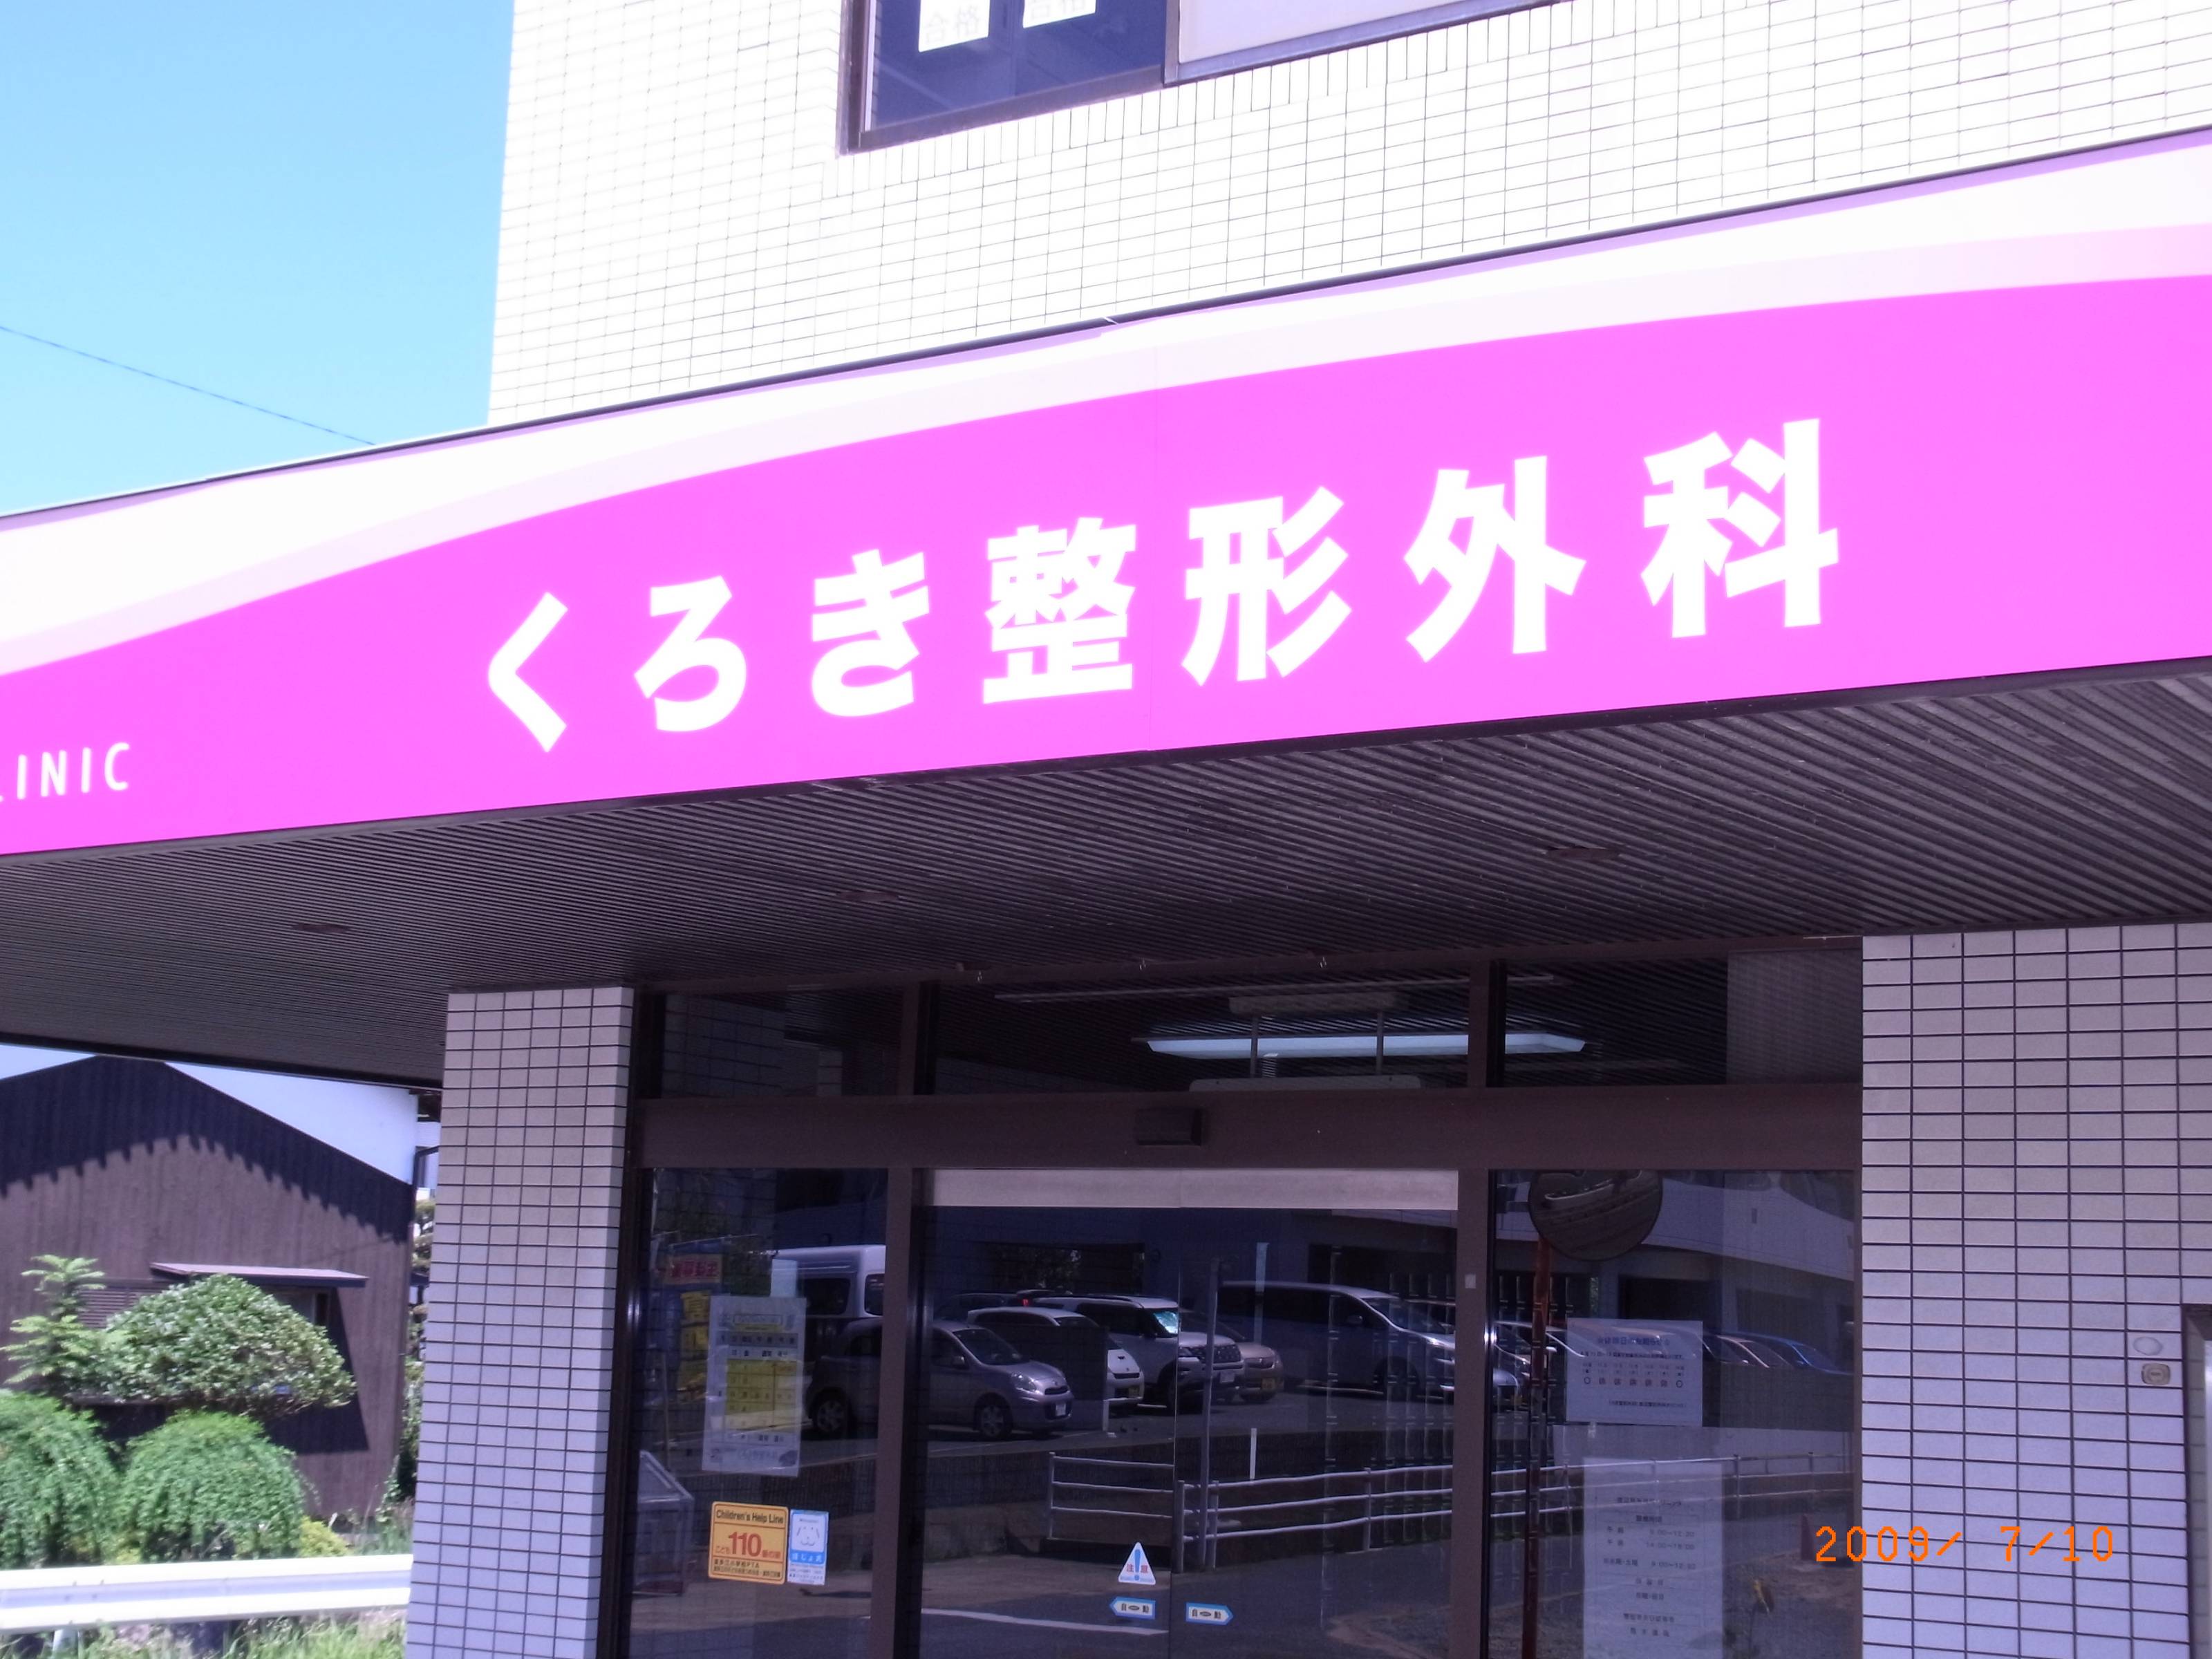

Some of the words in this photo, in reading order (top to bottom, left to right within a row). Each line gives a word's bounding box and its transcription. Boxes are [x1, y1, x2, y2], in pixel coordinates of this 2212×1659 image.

[487, 418, 1839, 753] くろき整形外科
[0, 742, 129, 803] INIC
[716, 1510, 751, 1521] Children's
[752, 1512, 767, 1523] Help
[769, 1514, 784, 1524] Line
